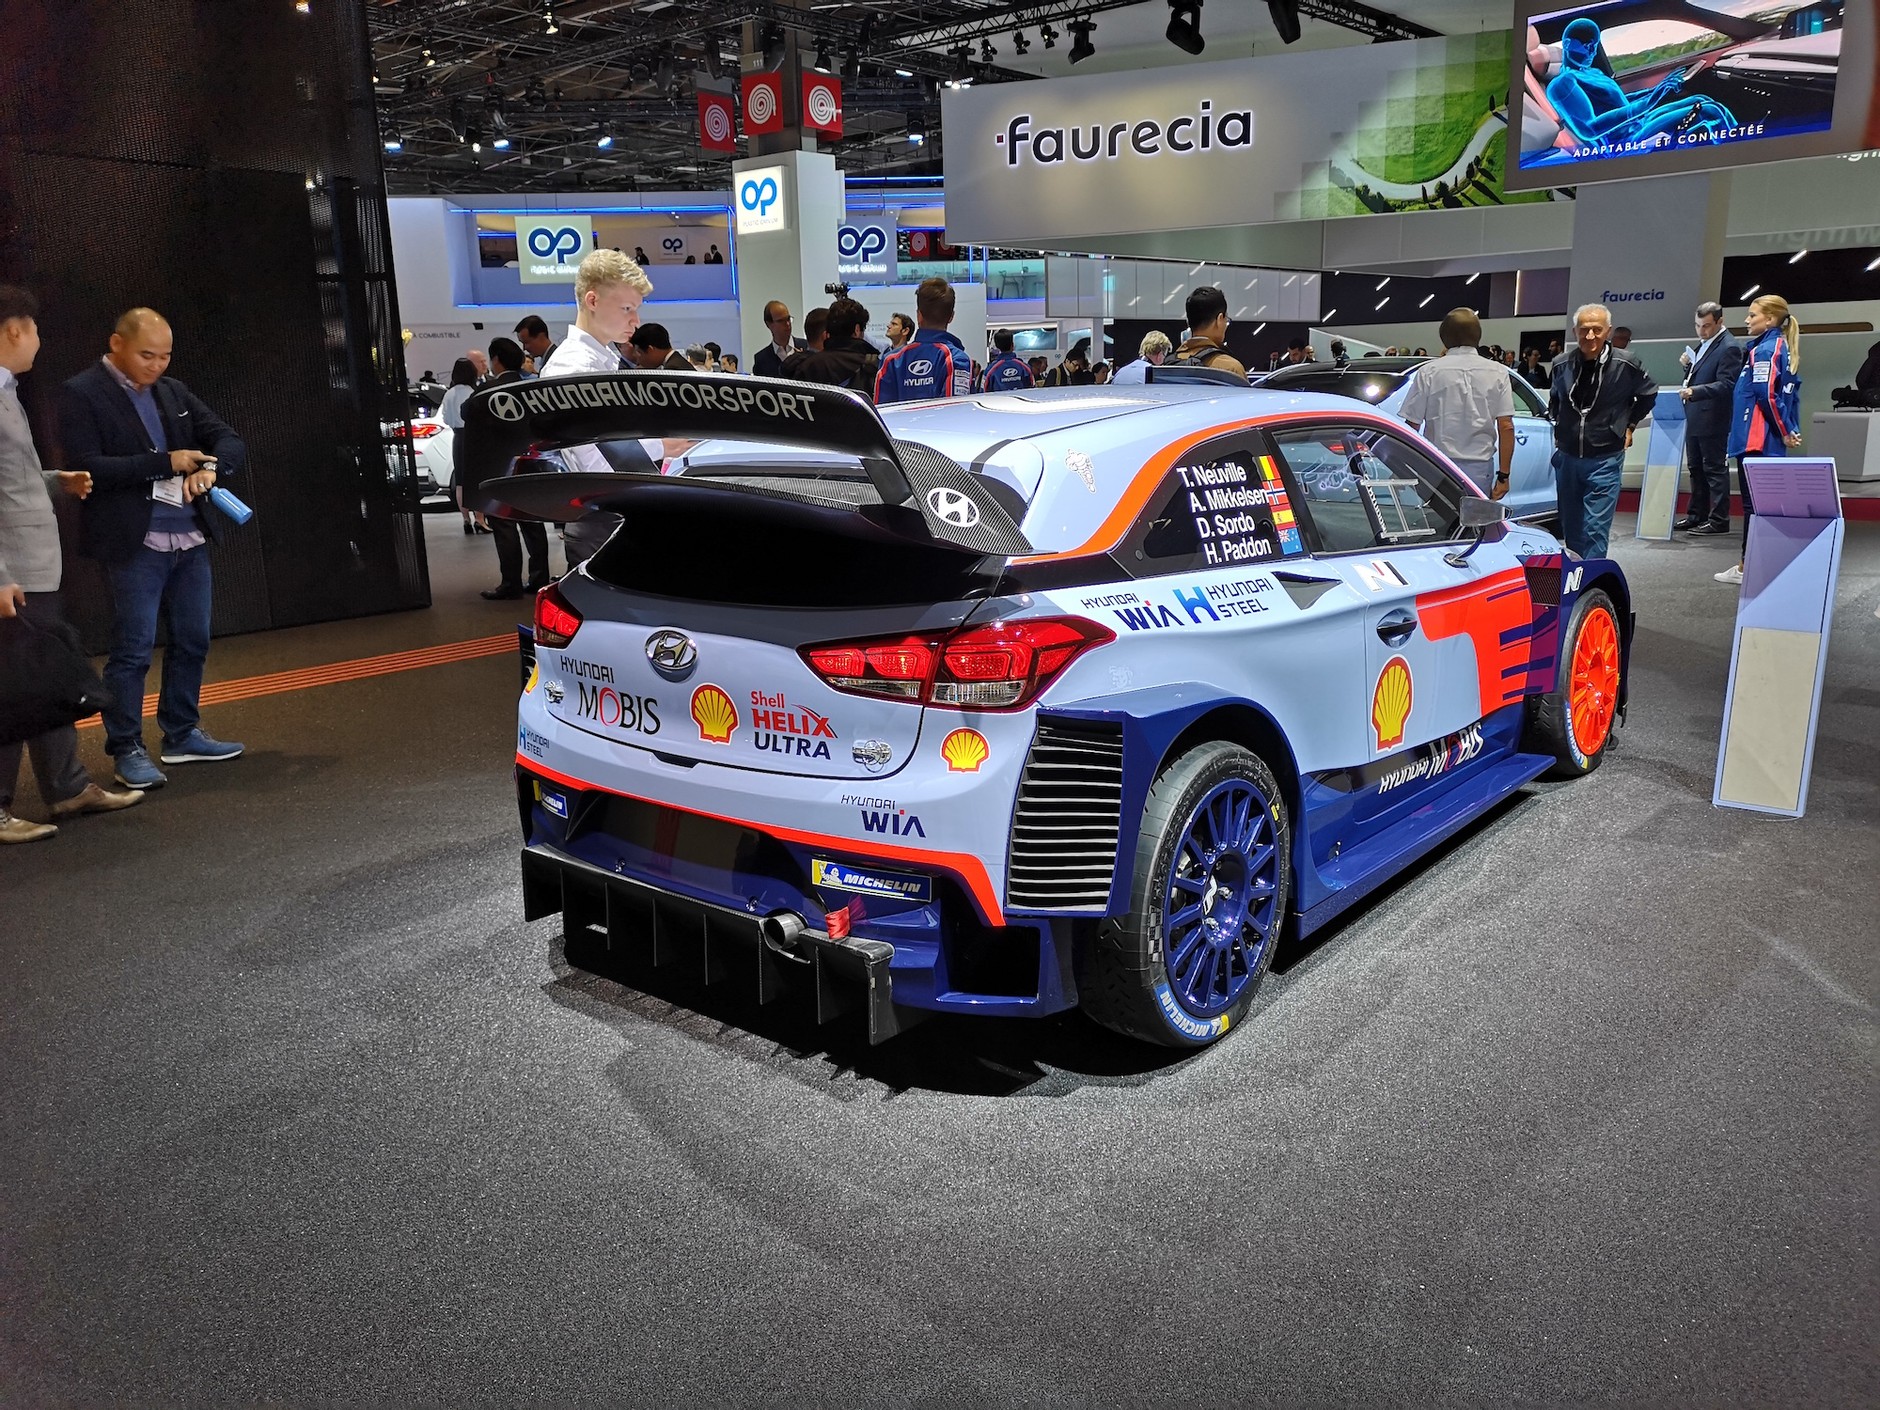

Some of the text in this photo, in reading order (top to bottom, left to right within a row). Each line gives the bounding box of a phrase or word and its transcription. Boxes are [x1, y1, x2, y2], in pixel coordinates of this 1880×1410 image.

[1008, 101, 1252, 165] faurecia
[1573, 123, 1765, 158] ADAPTABLE ET CONNECTÉE
[1602, 289, 1665, 303] faurecia
[1176, 462, 1247, 488] T. Neuville
[1189, 486, 1270, 513] A. Mikkelsen
[1196, 511, 1255, 539] D. Sordo
[1204, 536, 1272, 564] H. Paddon
[1080, 592, 1141, 610] HYUNDAI
[1205, 577, 1275, 601] HYUNDAI
[1217, 598, 1269, 618] STEEL
[560, 655, 615, 684] HYUNDAI
[577, 681, 661, 735] MOBIS
[751, 690, 785, 708] Shell
[751, 707, 836, 738] HELIX
[526, 742, 544, 758] STEEL
[527, 731, 550, 749] HYUNDAI
[754, 731, 831, 760] ULTRA
[1378, 721, 1484, 795] HYUNDAI MOBIS
[840, 794, 896, 810] HYUNDAI
[843, 873, 921, 893] MICHELIN
[1159, 990, 1211, 1037] MICHELIN
